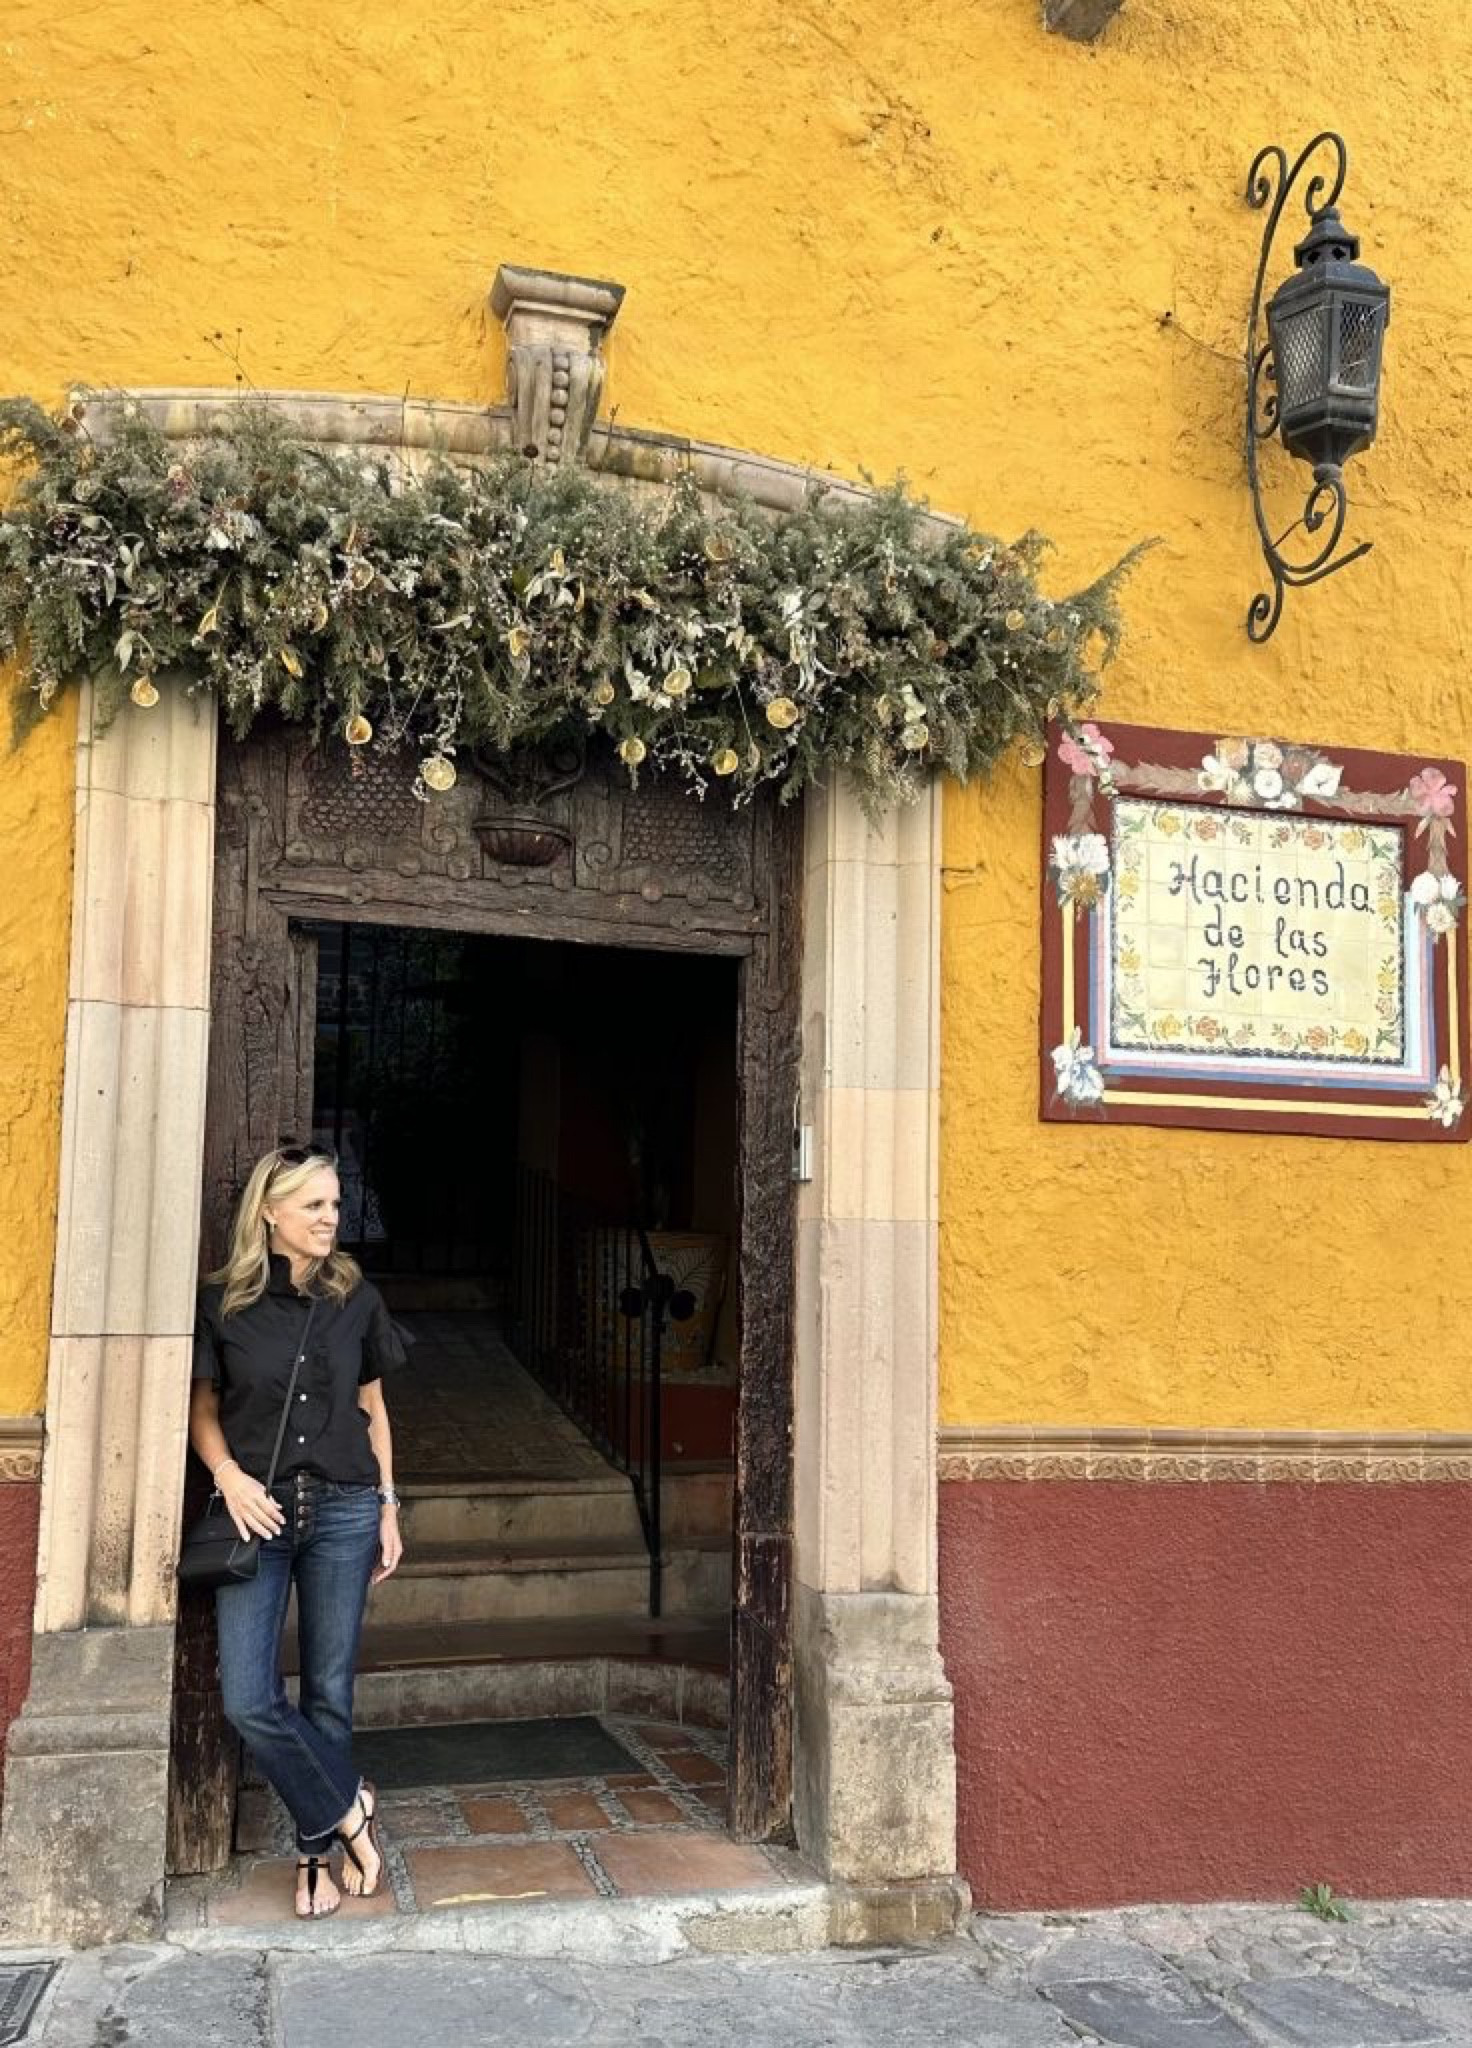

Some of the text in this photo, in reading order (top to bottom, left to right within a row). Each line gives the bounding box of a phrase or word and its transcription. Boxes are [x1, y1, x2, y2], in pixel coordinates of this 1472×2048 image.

[1169, 853, 1375, 914] Hacienda
[1204, 904, 1328, 958] de las
[1198, 952, 1329, 998] Flores
